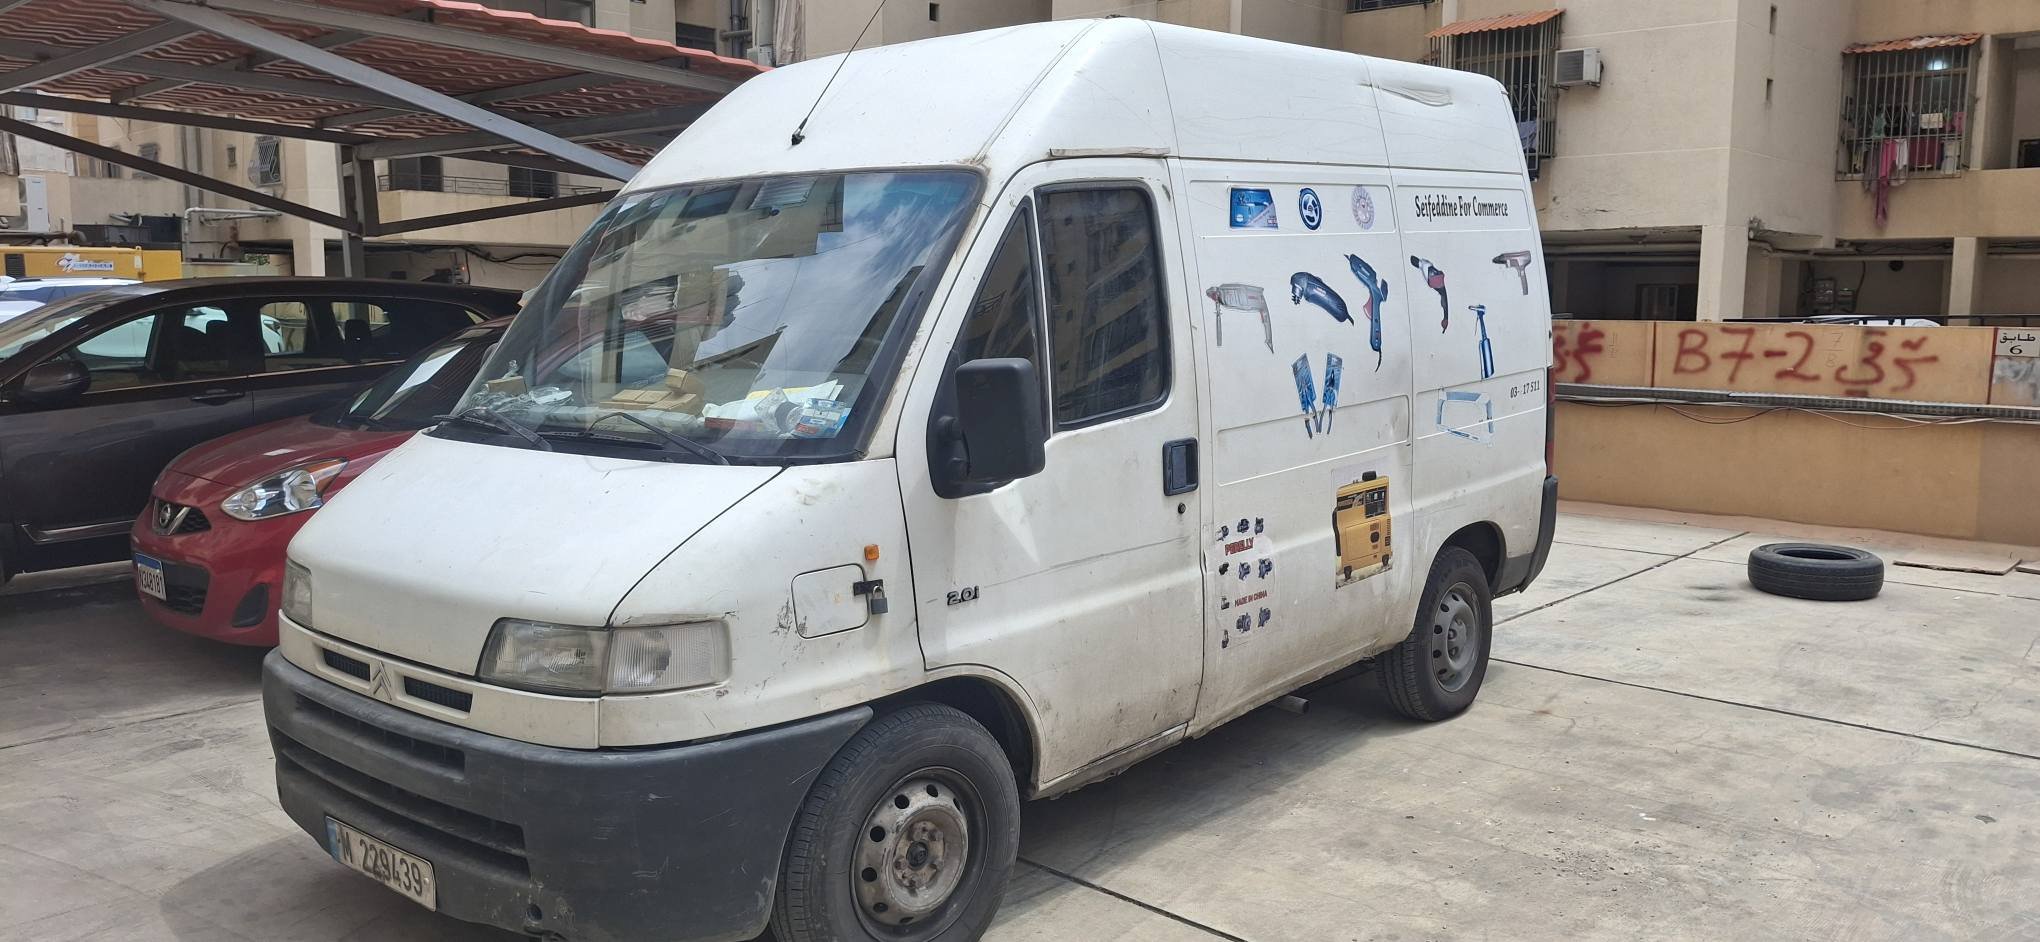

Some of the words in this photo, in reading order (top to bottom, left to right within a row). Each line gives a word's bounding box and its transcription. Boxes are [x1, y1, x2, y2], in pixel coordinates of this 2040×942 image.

[1414, 193, 1458, 222] Seifeddine
[1458, 195, 1471, 217] For
[1472, 195, 1508, 217] Commerce
[1999, 333, 2036, 344] طابق
[2009, 344, 2023, 355] 6
[360, 838, 422, 896] 229439
